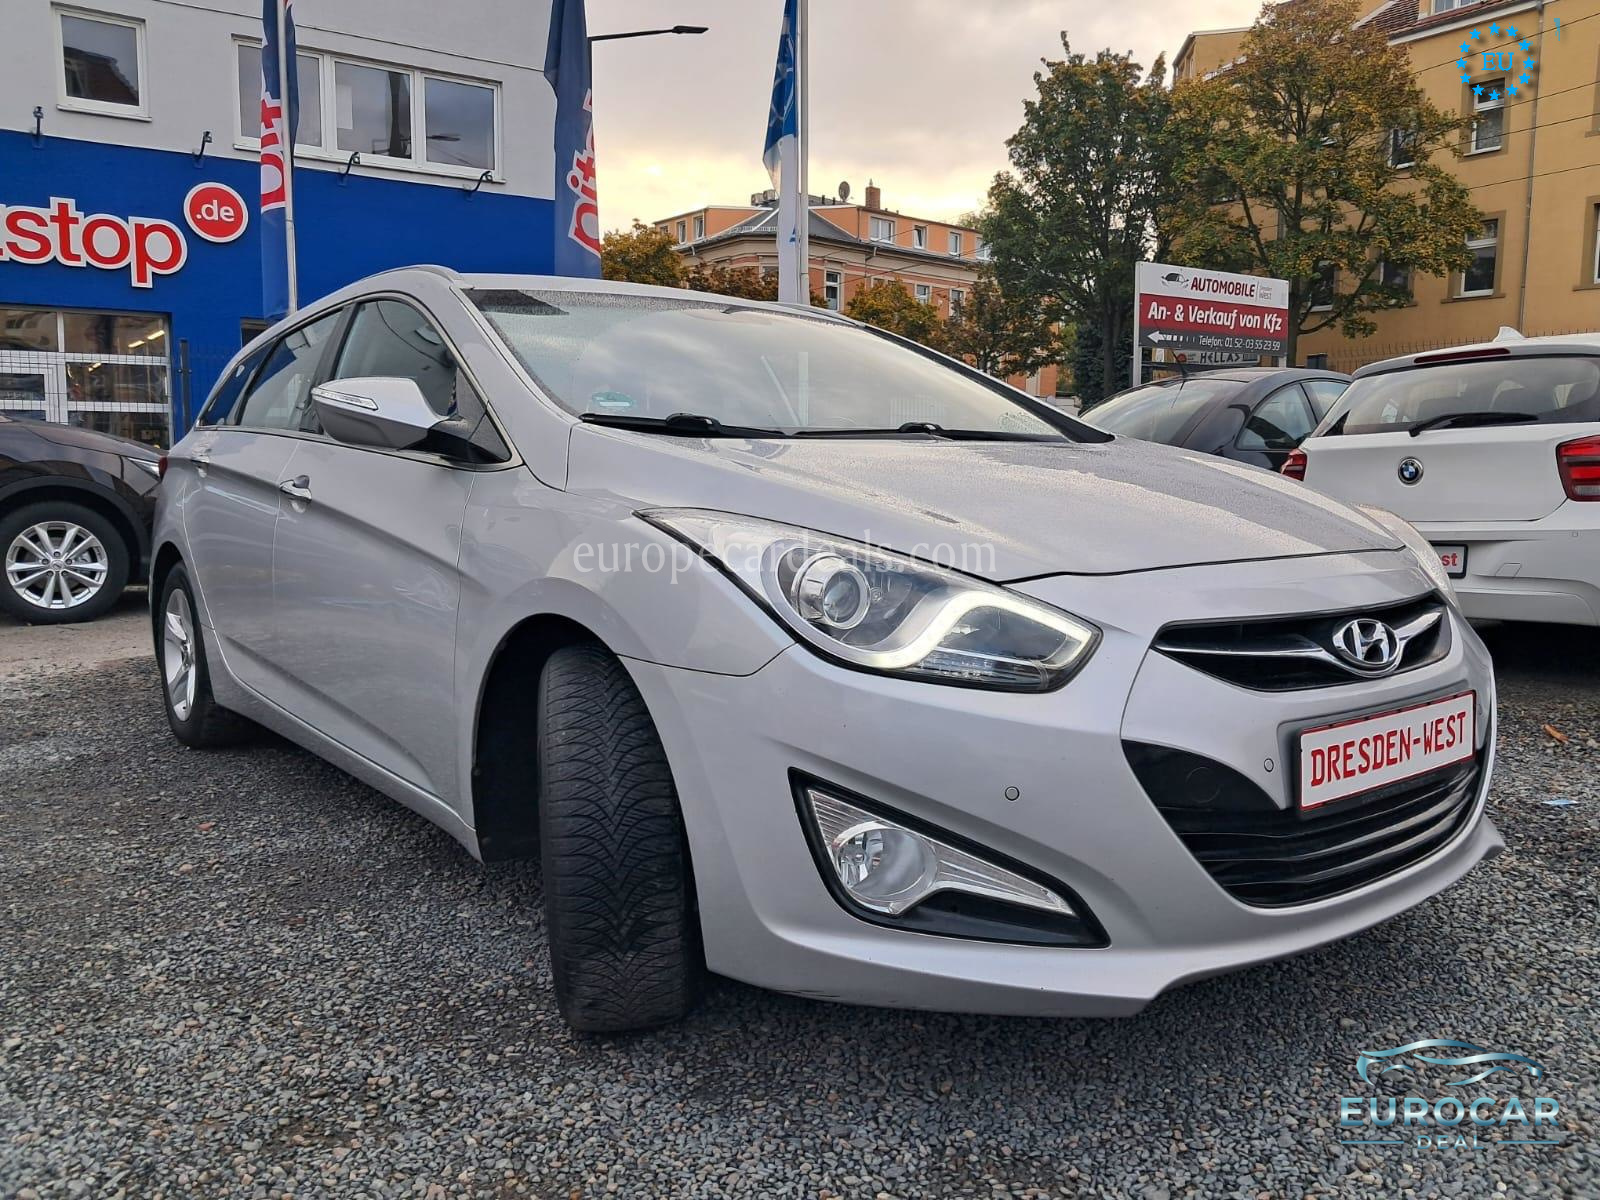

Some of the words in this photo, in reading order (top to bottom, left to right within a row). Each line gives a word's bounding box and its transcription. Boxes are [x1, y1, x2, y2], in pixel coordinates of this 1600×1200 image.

[0, 201, 184, 284] stop
[196, 199, 235, 222] .de
[1190, 276, 1256, 298] AUTOMOBILE
[1148, 301, 1171, 320] An-
[1174, 304, 1185, 322] &
[1188, 305, 1238, 329] Verkauf
[1239, 314, 1261, 329] von
[1263, 313, 1283, 333] Kfz
[1310, 711, 1467, 787] DRESDEN-WEST
